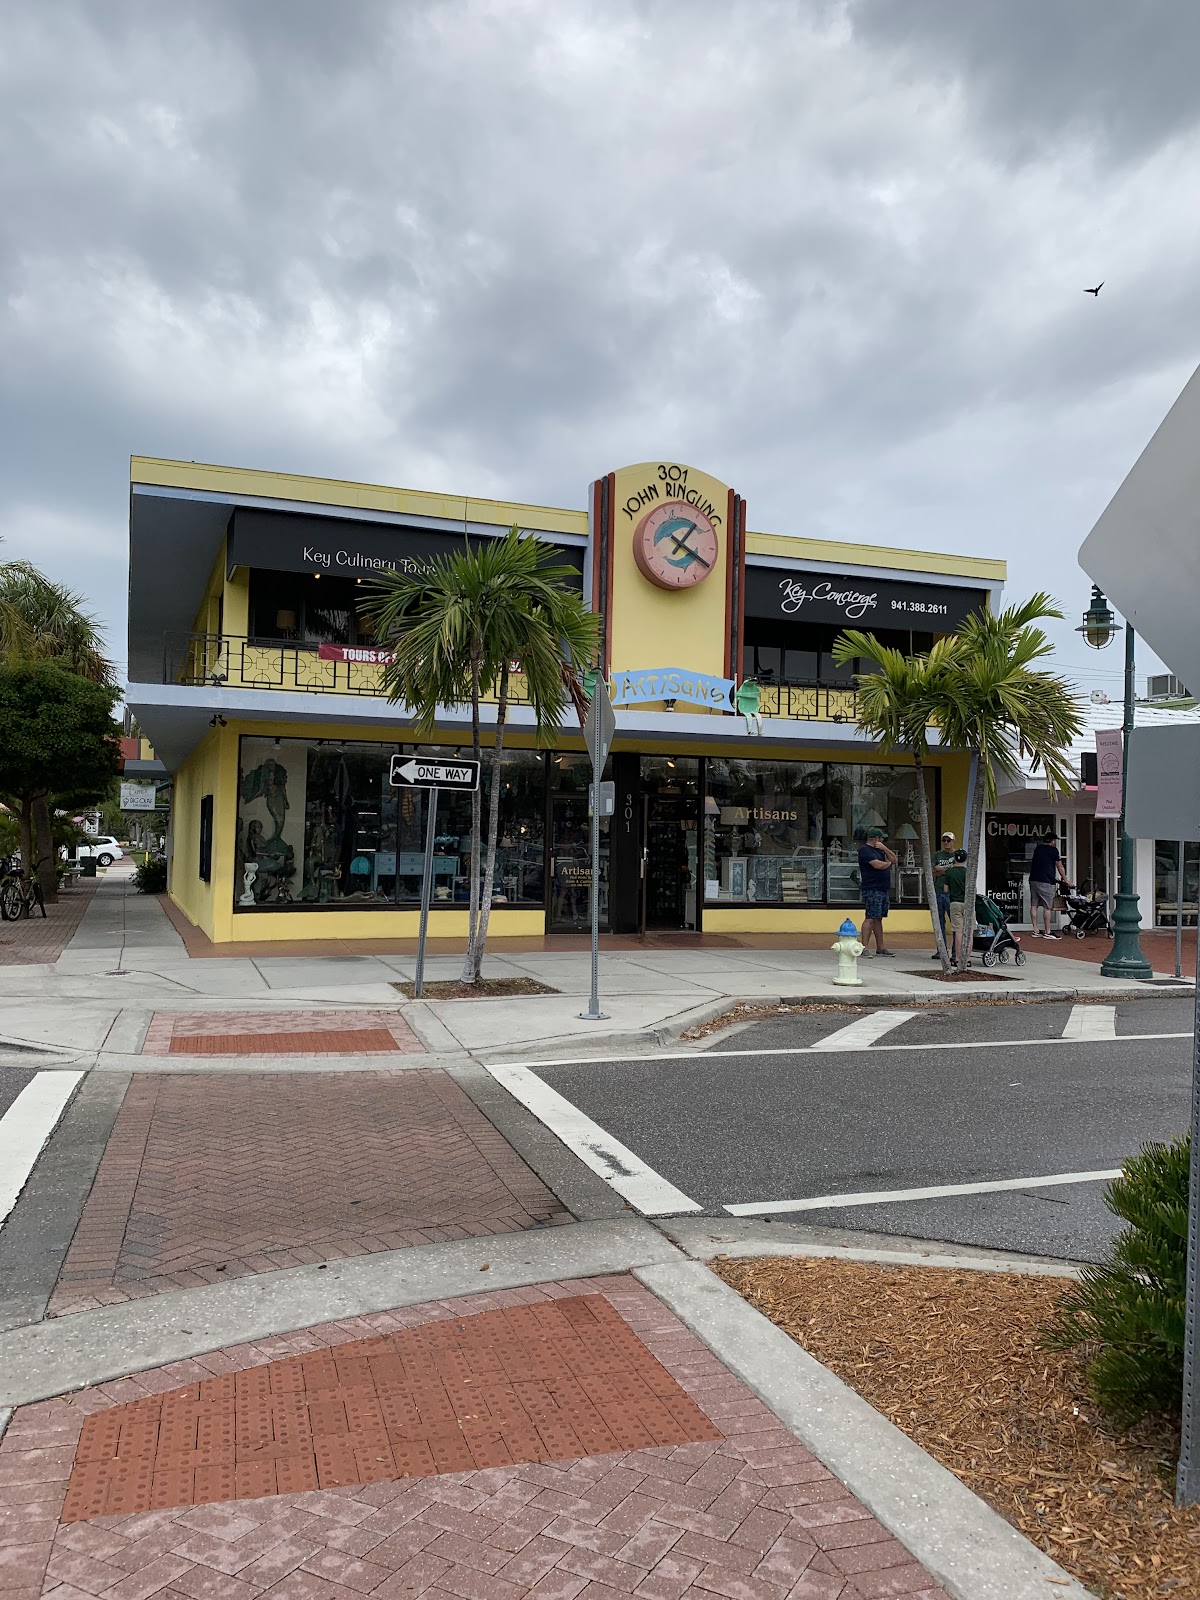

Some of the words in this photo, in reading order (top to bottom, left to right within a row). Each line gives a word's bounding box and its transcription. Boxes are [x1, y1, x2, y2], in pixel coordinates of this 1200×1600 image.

[658, 464, 689, 484] 301
[622, 483, 660, 521] JOHN
[665, 481, 722, 528] RINGLING
[303, 546, 331, 567] Key
[335, 550, 396, 572] Culinary
[779, 578, 813, 613] Key
[812, 582, 878, 618] Concierge
[891, 600, 948, 615] 941.388.2611
[342, 647, 376, 662] TOURS
[417, 766, 441, 779] ONE
[445, 768, 469, 780] WAY
[624, 793, 633, 833] 301
[734, 806, 798, 820] Artisans
[86, 825, 97, 833] 25
[987, 821, 1052, 837] CHOULALA
[1008, 880, 1018, 888] The
[987, 889, 1018, 900] French
